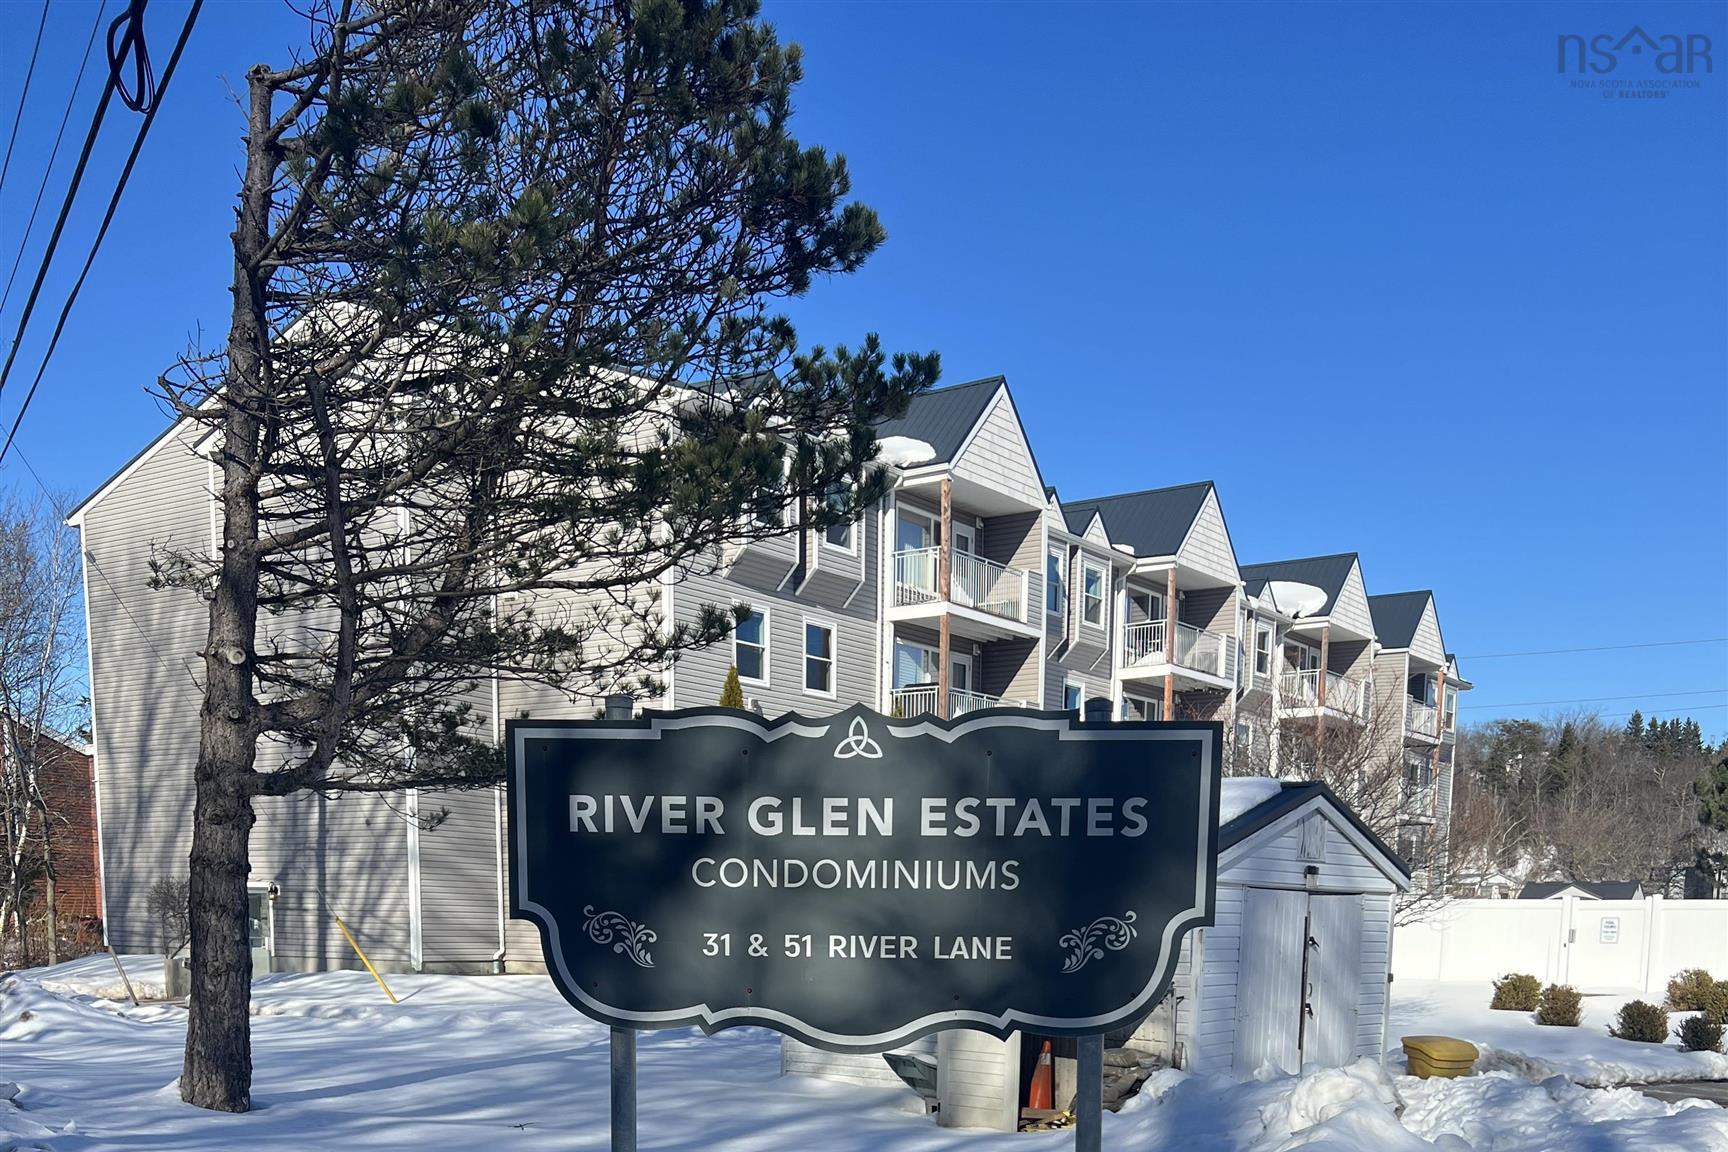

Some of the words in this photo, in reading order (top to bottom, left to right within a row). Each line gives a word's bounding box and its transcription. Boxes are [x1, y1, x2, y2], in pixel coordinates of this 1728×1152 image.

[569, 794, 726, 835] RIVER
[747, 796, 894, 837] GLEN
[920, 796, 1149, 838] ESTATES
[691, 857, 1020, 891] CONDOMINIUMS
[702, 932, 731, 957] 31
[747, 933, 769, 957] &
[784, 934, 813, 958] 51
[828, 934, 918, 960] RIVER
[934, 935, 1013, 961] LANE
